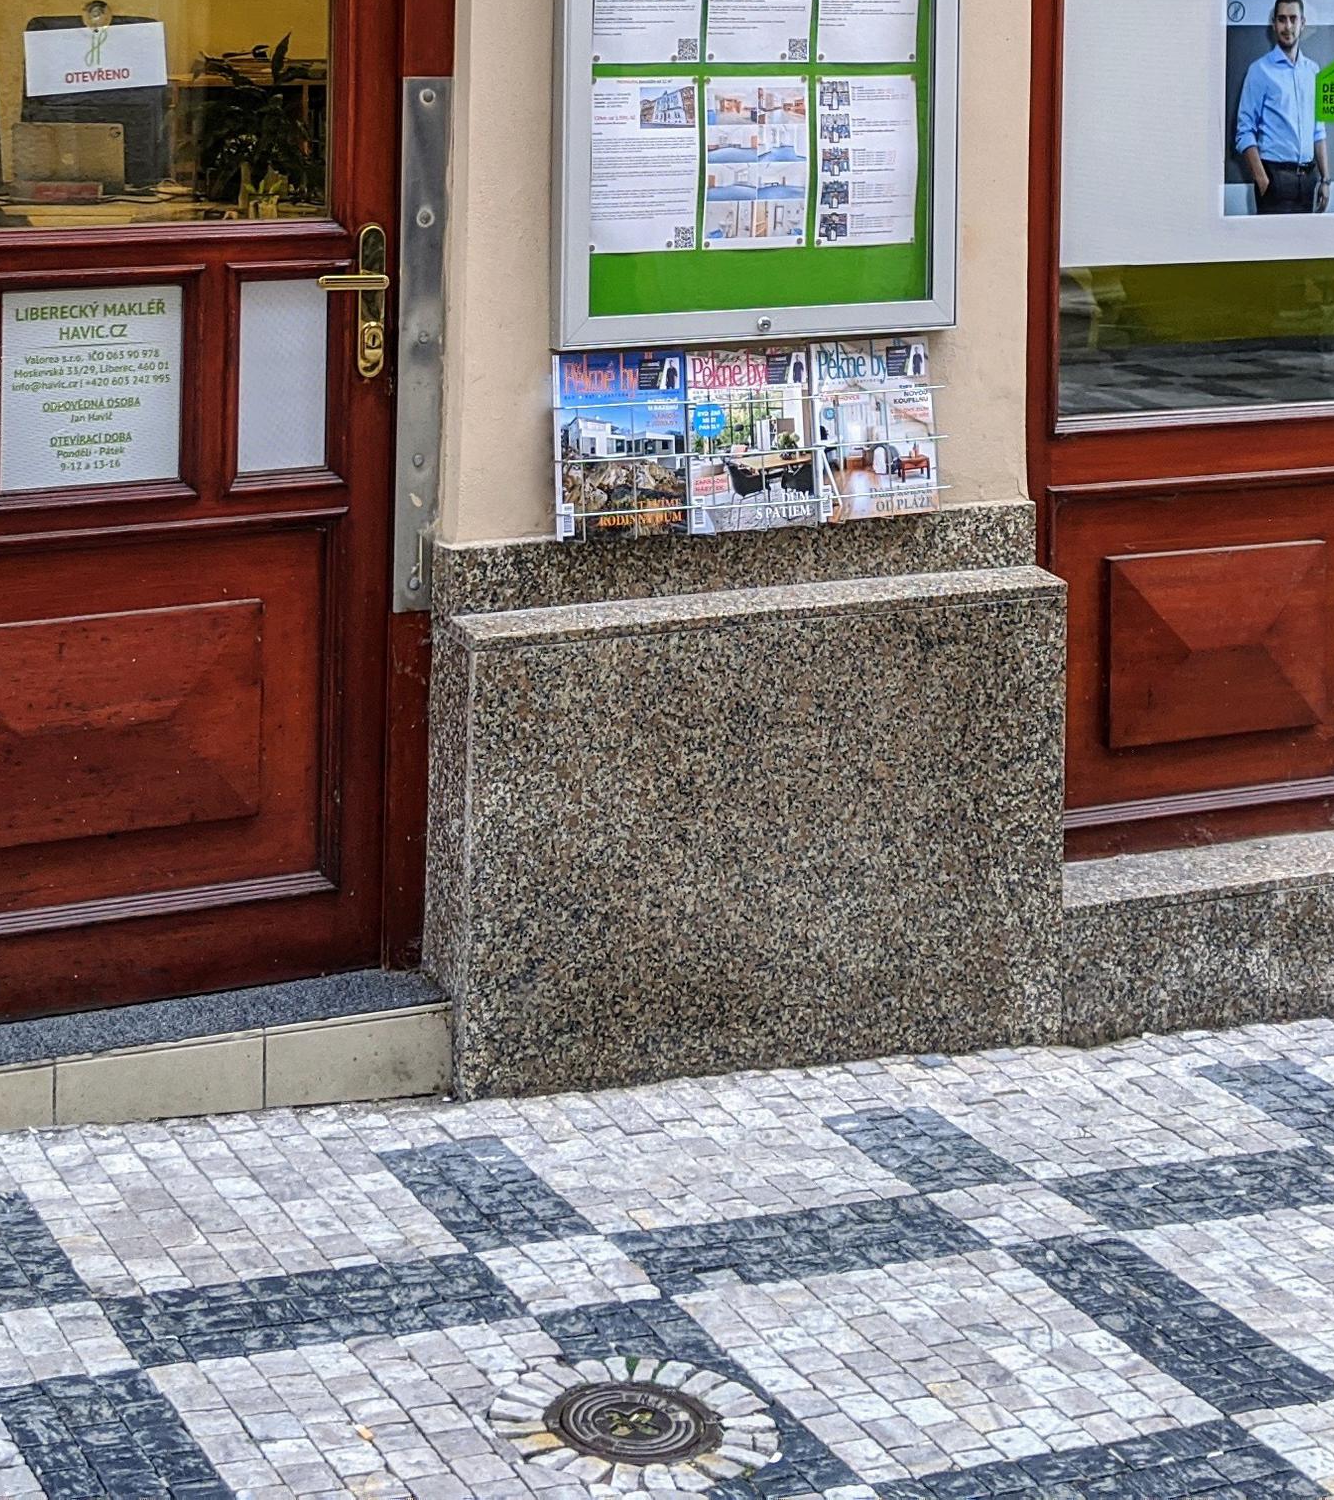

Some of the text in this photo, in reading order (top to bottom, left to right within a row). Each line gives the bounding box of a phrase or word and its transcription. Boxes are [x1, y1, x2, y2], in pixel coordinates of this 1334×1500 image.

[65, 68, 130, 84] OTEVŘENO
[16, 299, 166, 322] LIBERECKÝ MAKLÉŘ
[59, 324, 128, 340] HAVIC.CZ
[816, 341, 866, 380] Pěkné
[691, 350, 742, 389] Pěkné
[107, 397, 141, 408] OSOBA
[70, 414, 85, 423] Jan
[104, 432, 132, 444] DOBA
